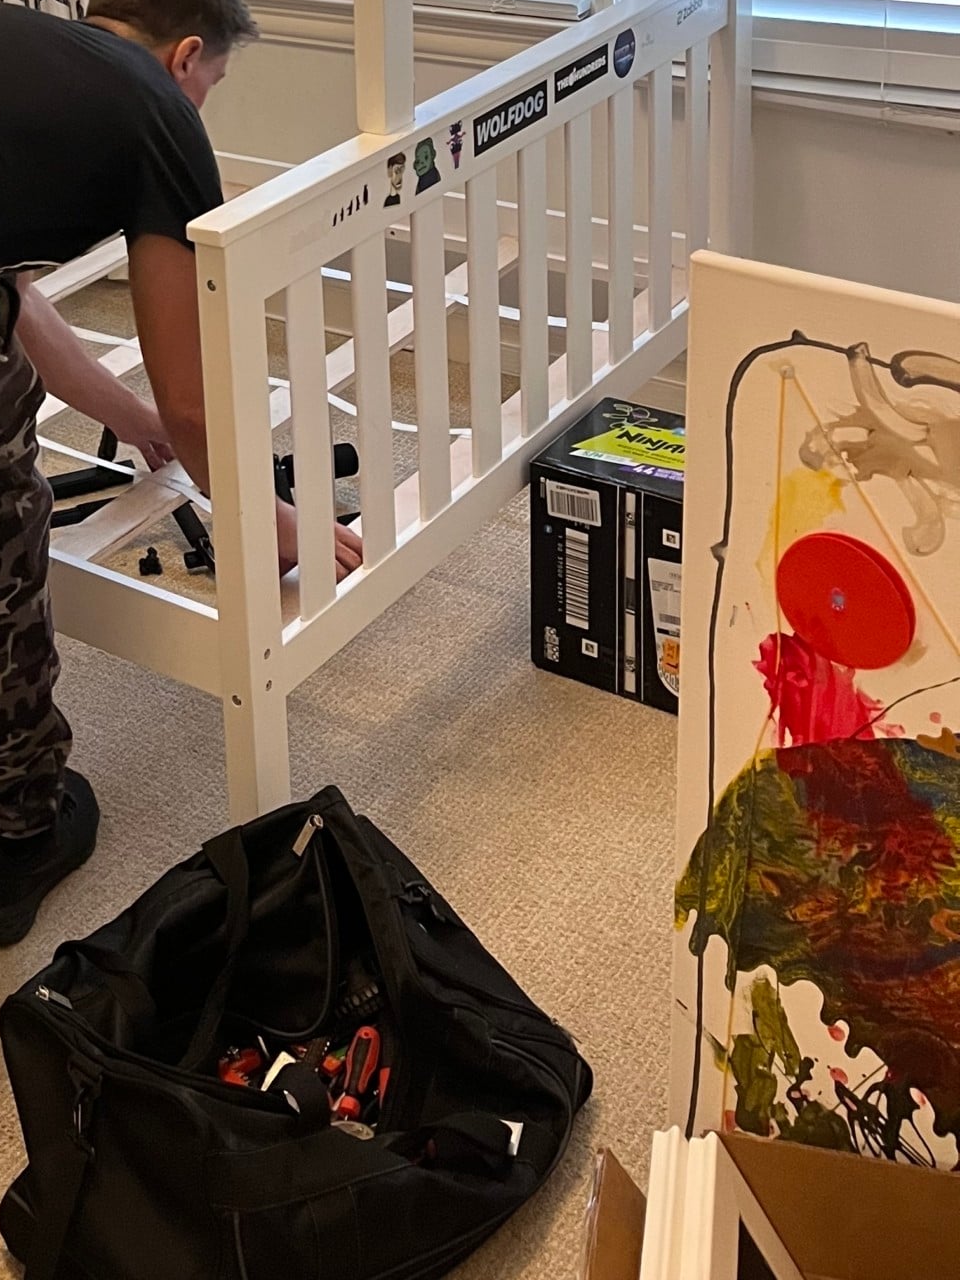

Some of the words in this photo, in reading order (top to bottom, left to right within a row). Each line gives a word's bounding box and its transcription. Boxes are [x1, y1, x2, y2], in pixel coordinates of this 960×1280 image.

[556, 78, 570, 92] THE
[574, 55, 607, 83] HUNDREDS
[476, 90, 545, 147] WOLFDOG
